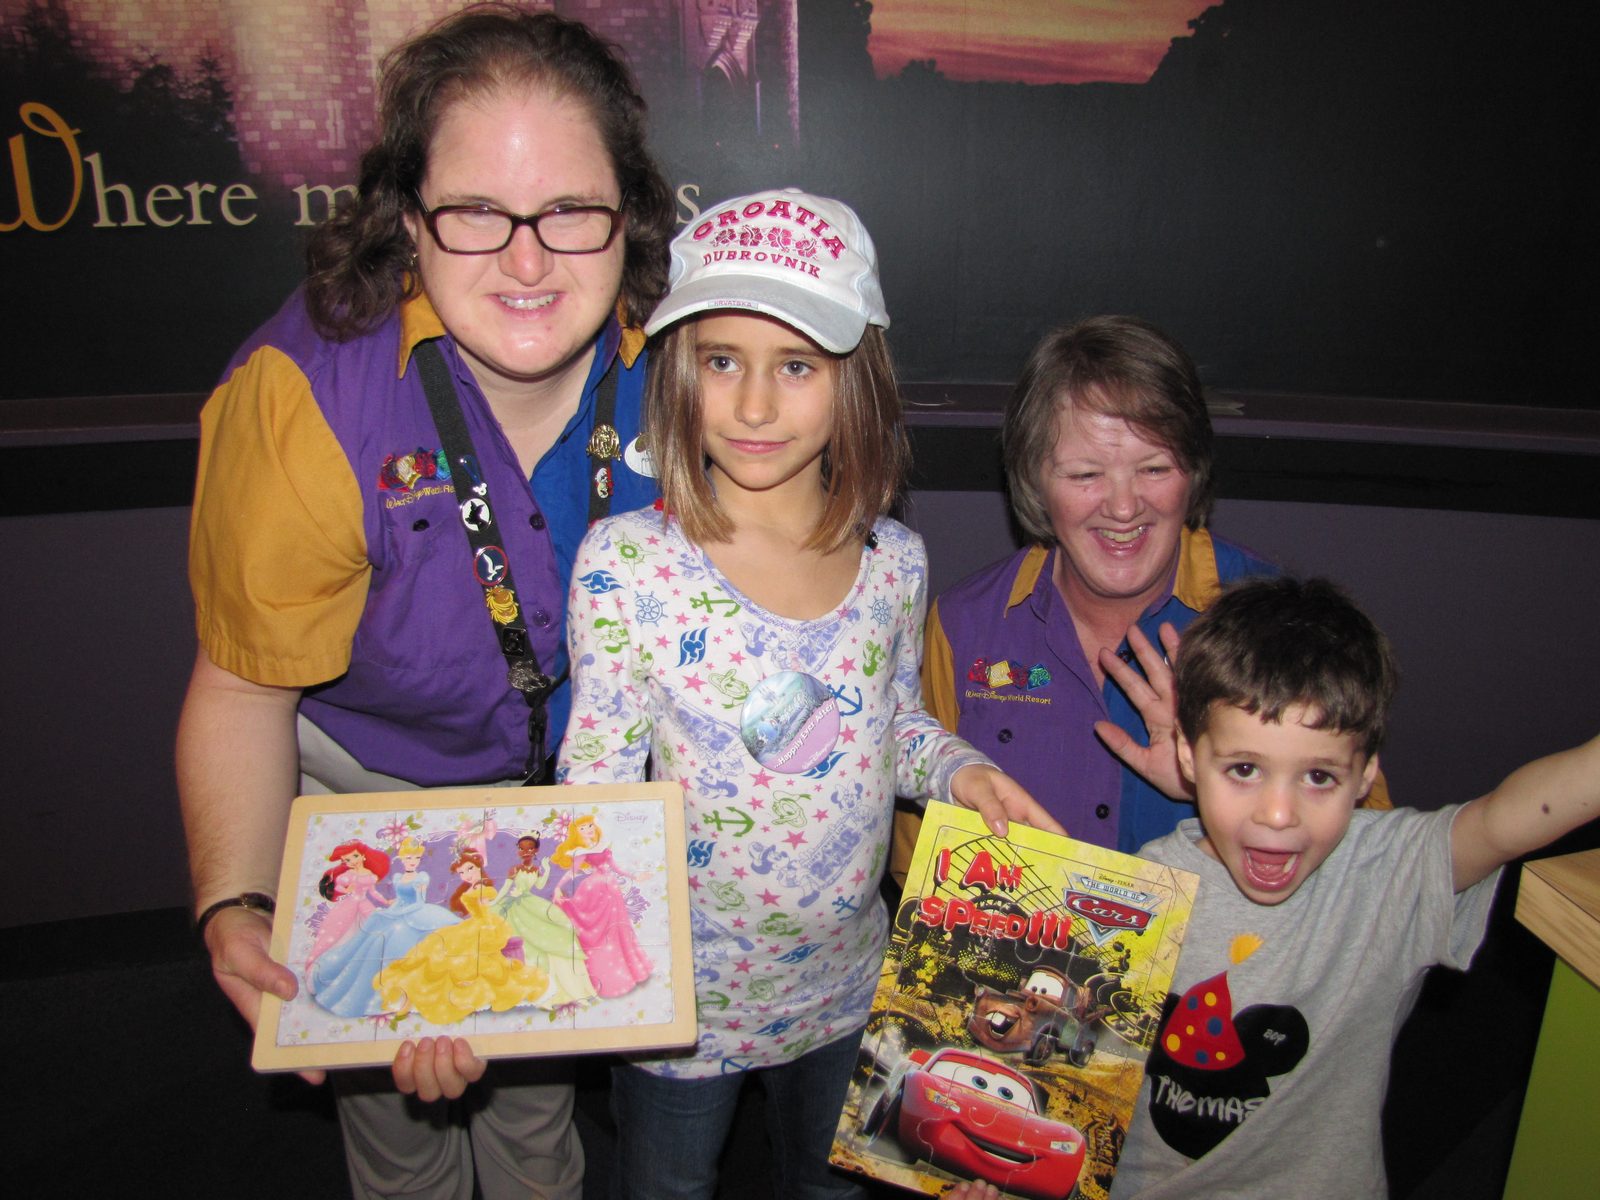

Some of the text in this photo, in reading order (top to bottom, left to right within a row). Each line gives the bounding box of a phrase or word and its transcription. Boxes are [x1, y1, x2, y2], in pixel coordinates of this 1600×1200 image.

[0, 101, 257, 232] Where
[693, 200, 847, 260] CROATIA
[703, 250, 821, 279] DUBROVNIK
[1025, 695, 1052, 704] Resort
[936, 848, 951, 885] I
[1086, 879, 1142, 901] THE WORLD OF
[1072, 897, 1140, 927] Cars
